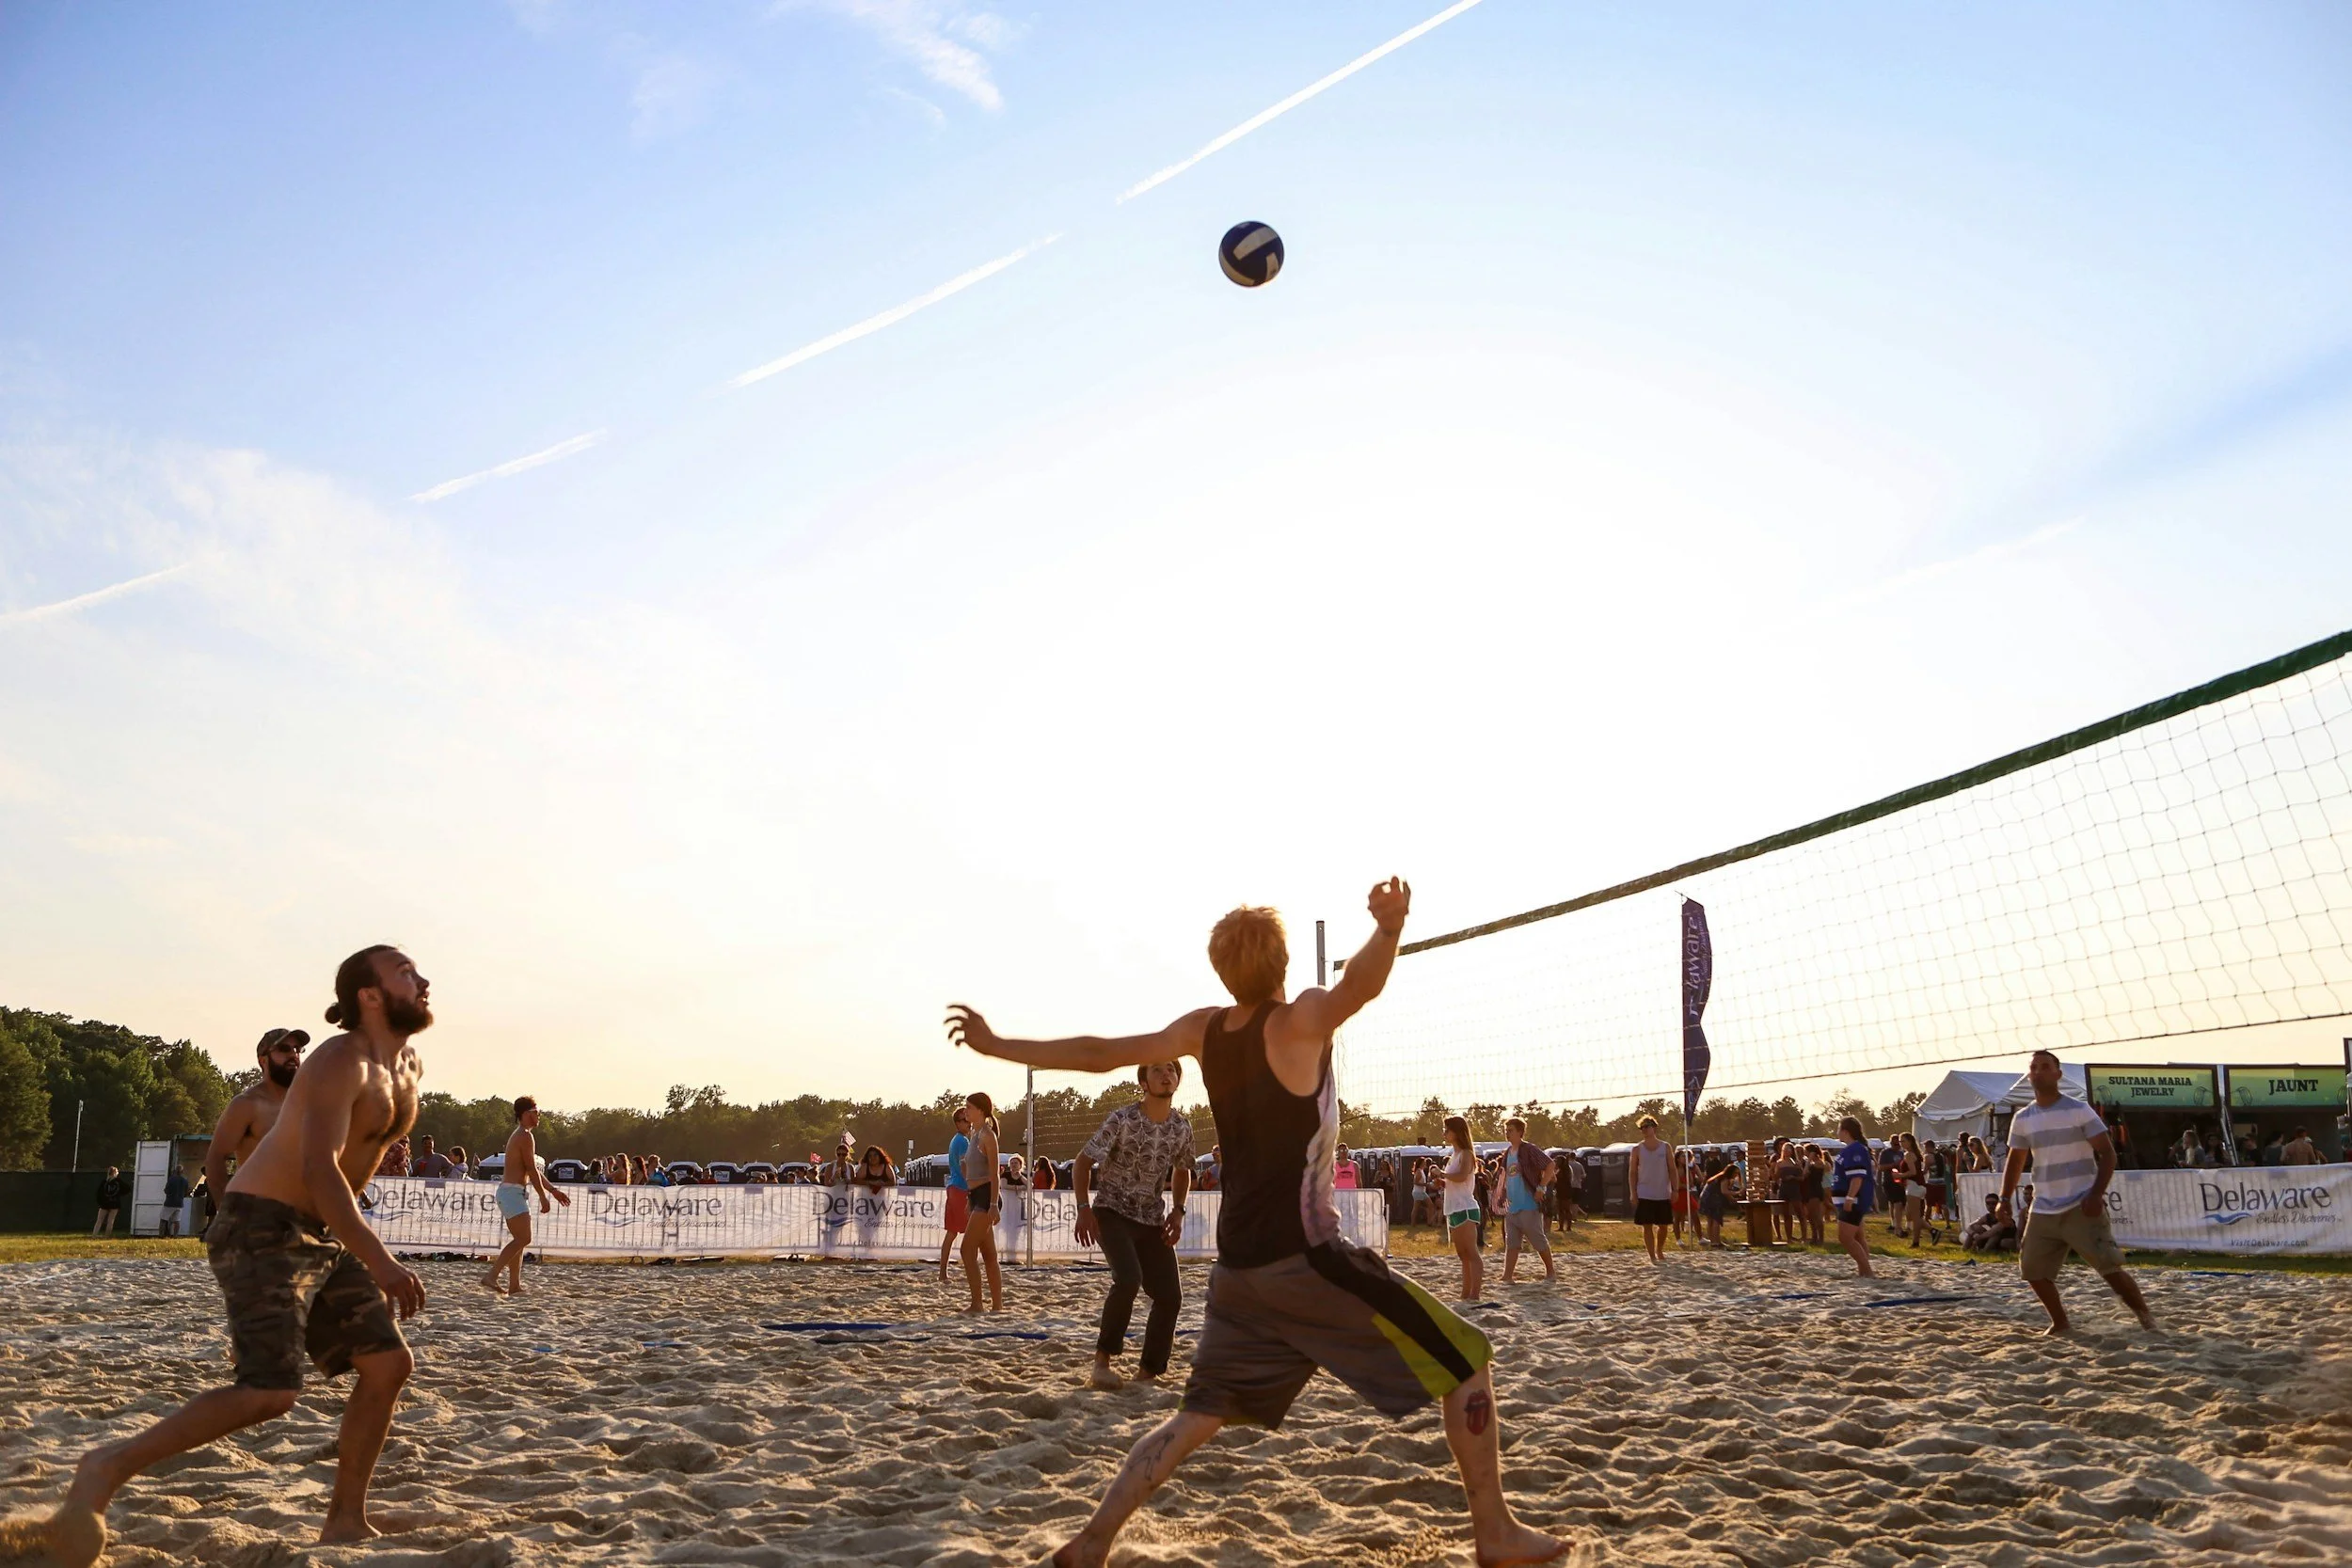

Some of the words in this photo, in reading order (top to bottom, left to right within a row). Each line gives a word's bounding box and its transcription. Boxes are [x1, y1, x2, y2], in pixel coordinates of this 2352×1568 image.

[2108, 1076, 2156, 1086] SULTANA
[2158, 1077, 2193, 1086] MARIA
[2268, 1079, 2319, 1096] JAUNT
[2130, 1087, 2175, 1098] JEWELRY
[588, 1189, 723, 1218] Delaware
[811, 1191, 935, 1219] Delaware
[2199, 1181, 2332, 1212] Delaware
[2256, 1212, 2290, 1224] Endless
